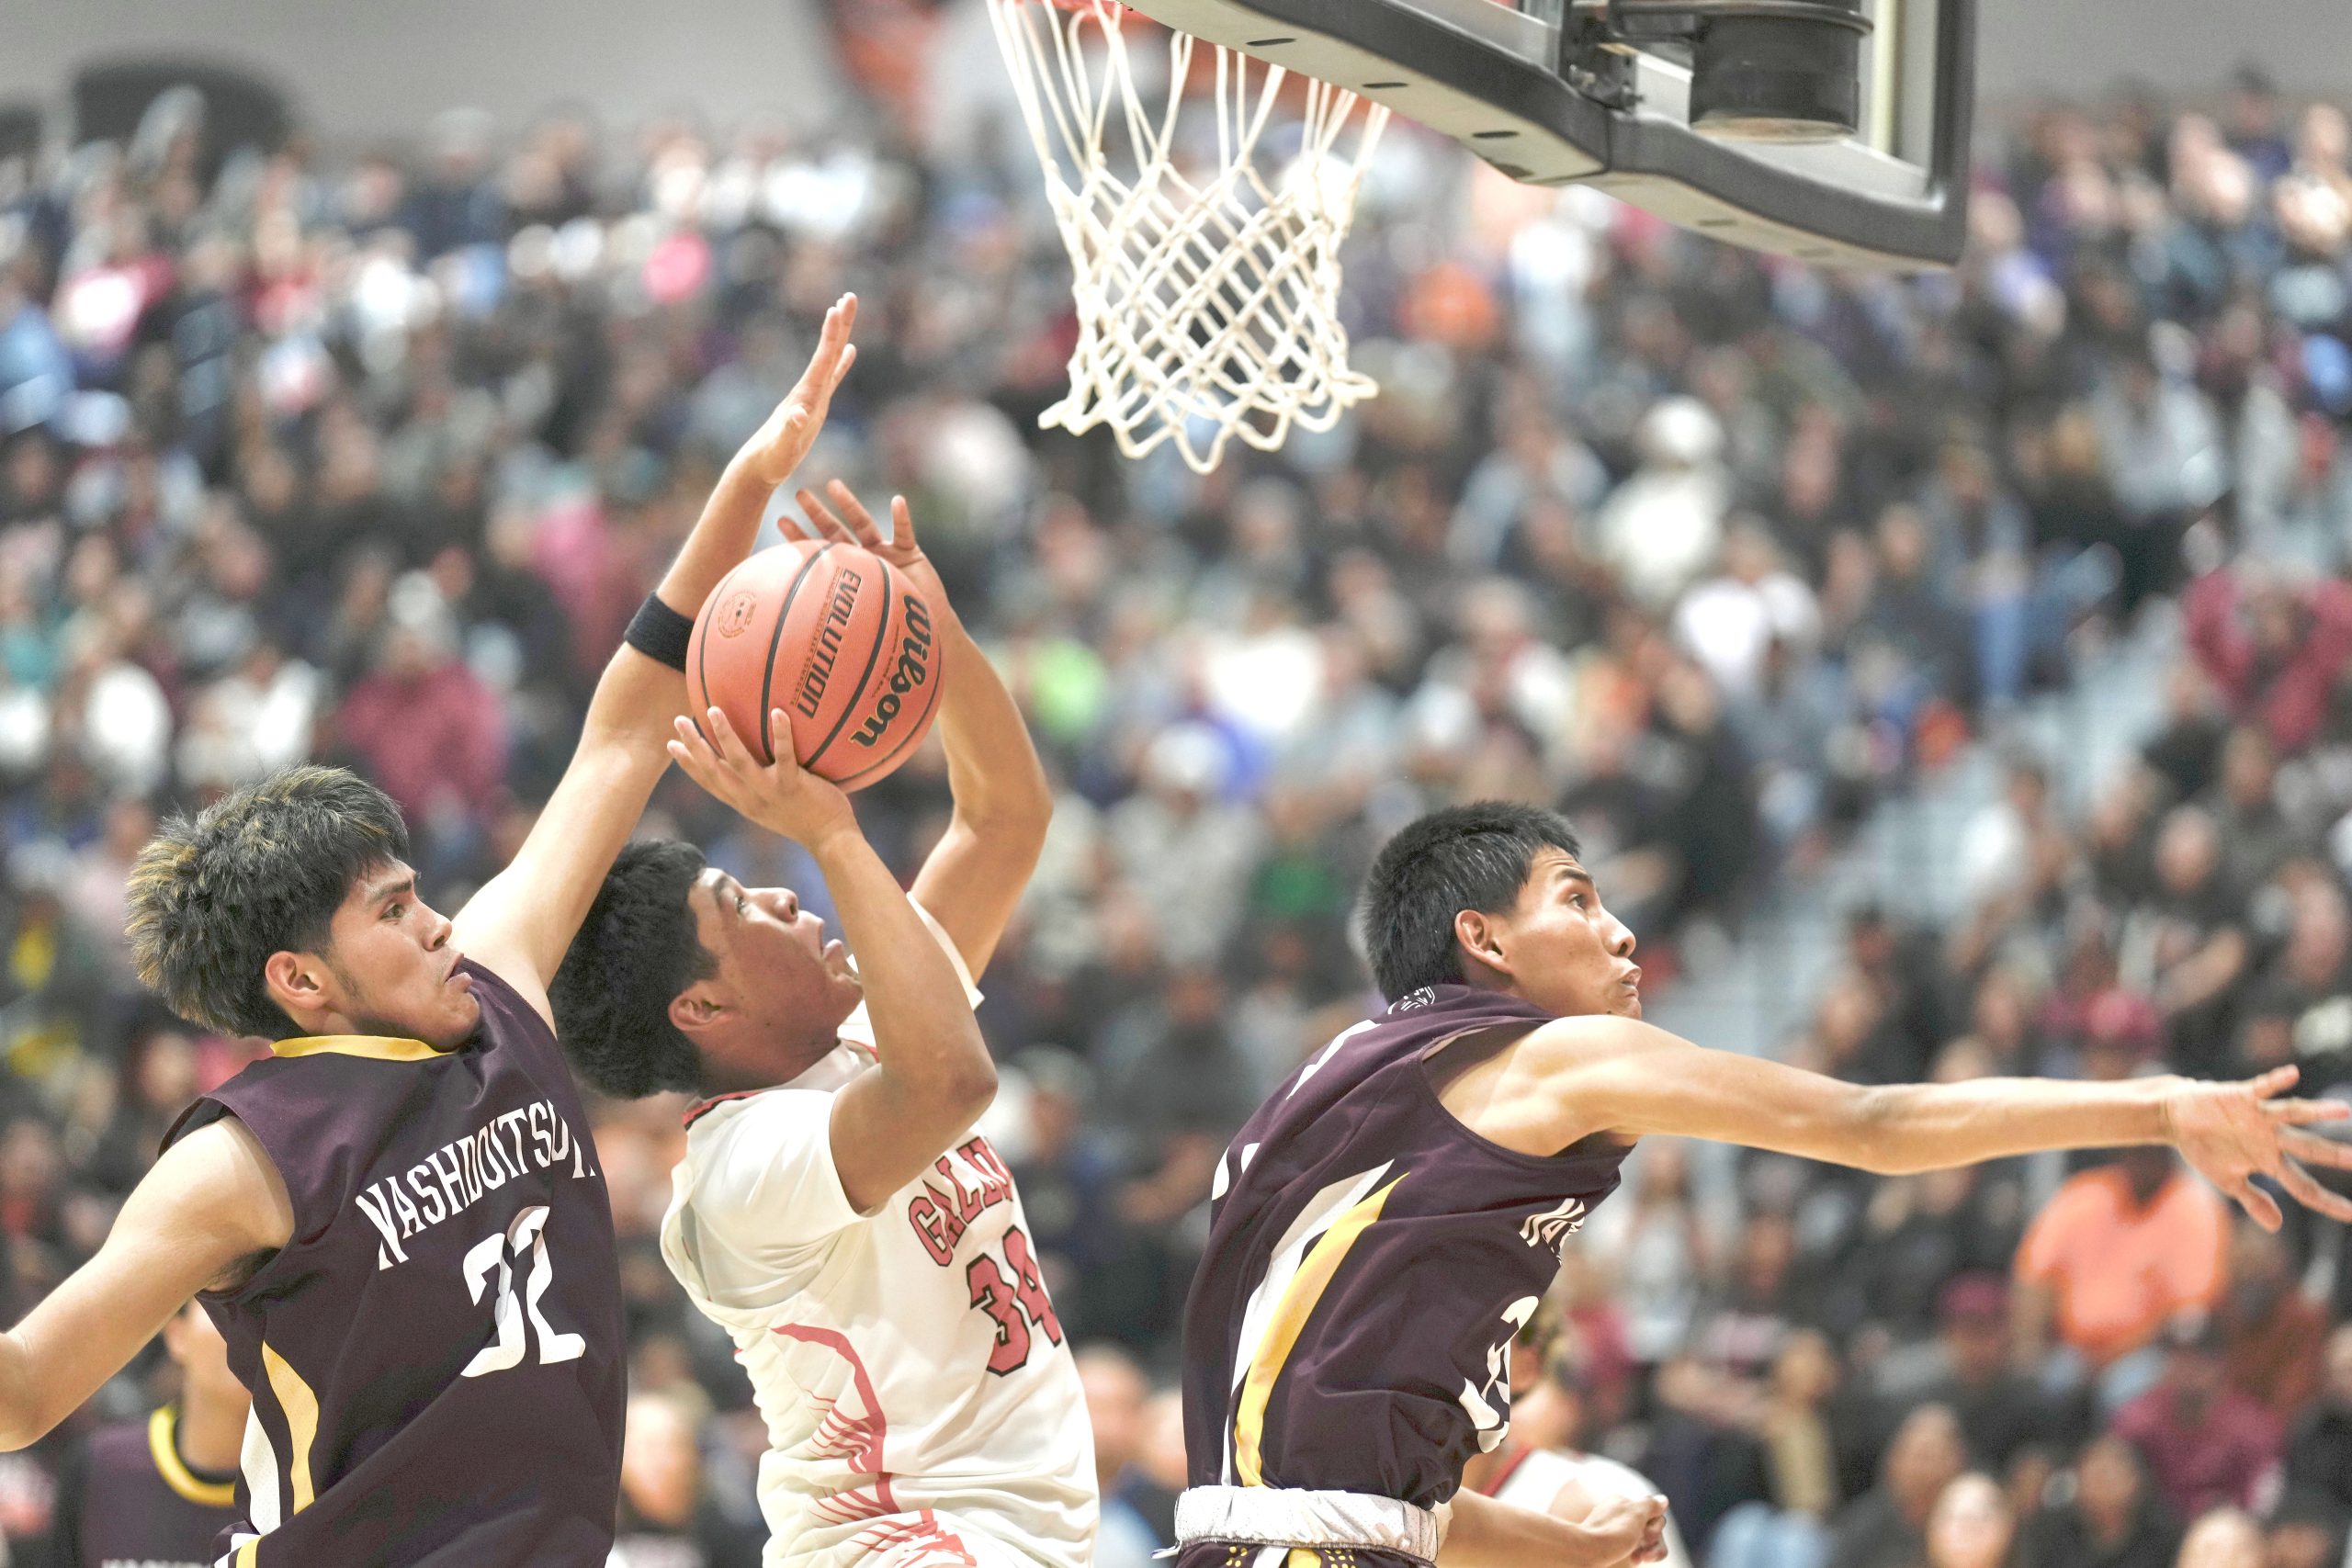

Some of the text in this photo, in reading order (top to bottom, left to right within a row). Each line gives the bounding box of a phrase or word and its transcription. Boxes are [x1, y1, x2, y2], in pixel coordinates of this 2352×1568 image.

[797, 568, 862, 719] EVOLUTION
[850, 594, 932, 748] Wilson
[909, 1135, 1013, 1268] GALLU
[460, 1205, 586, 1378] 32
[967, 1224, 1061, 1377] 34
